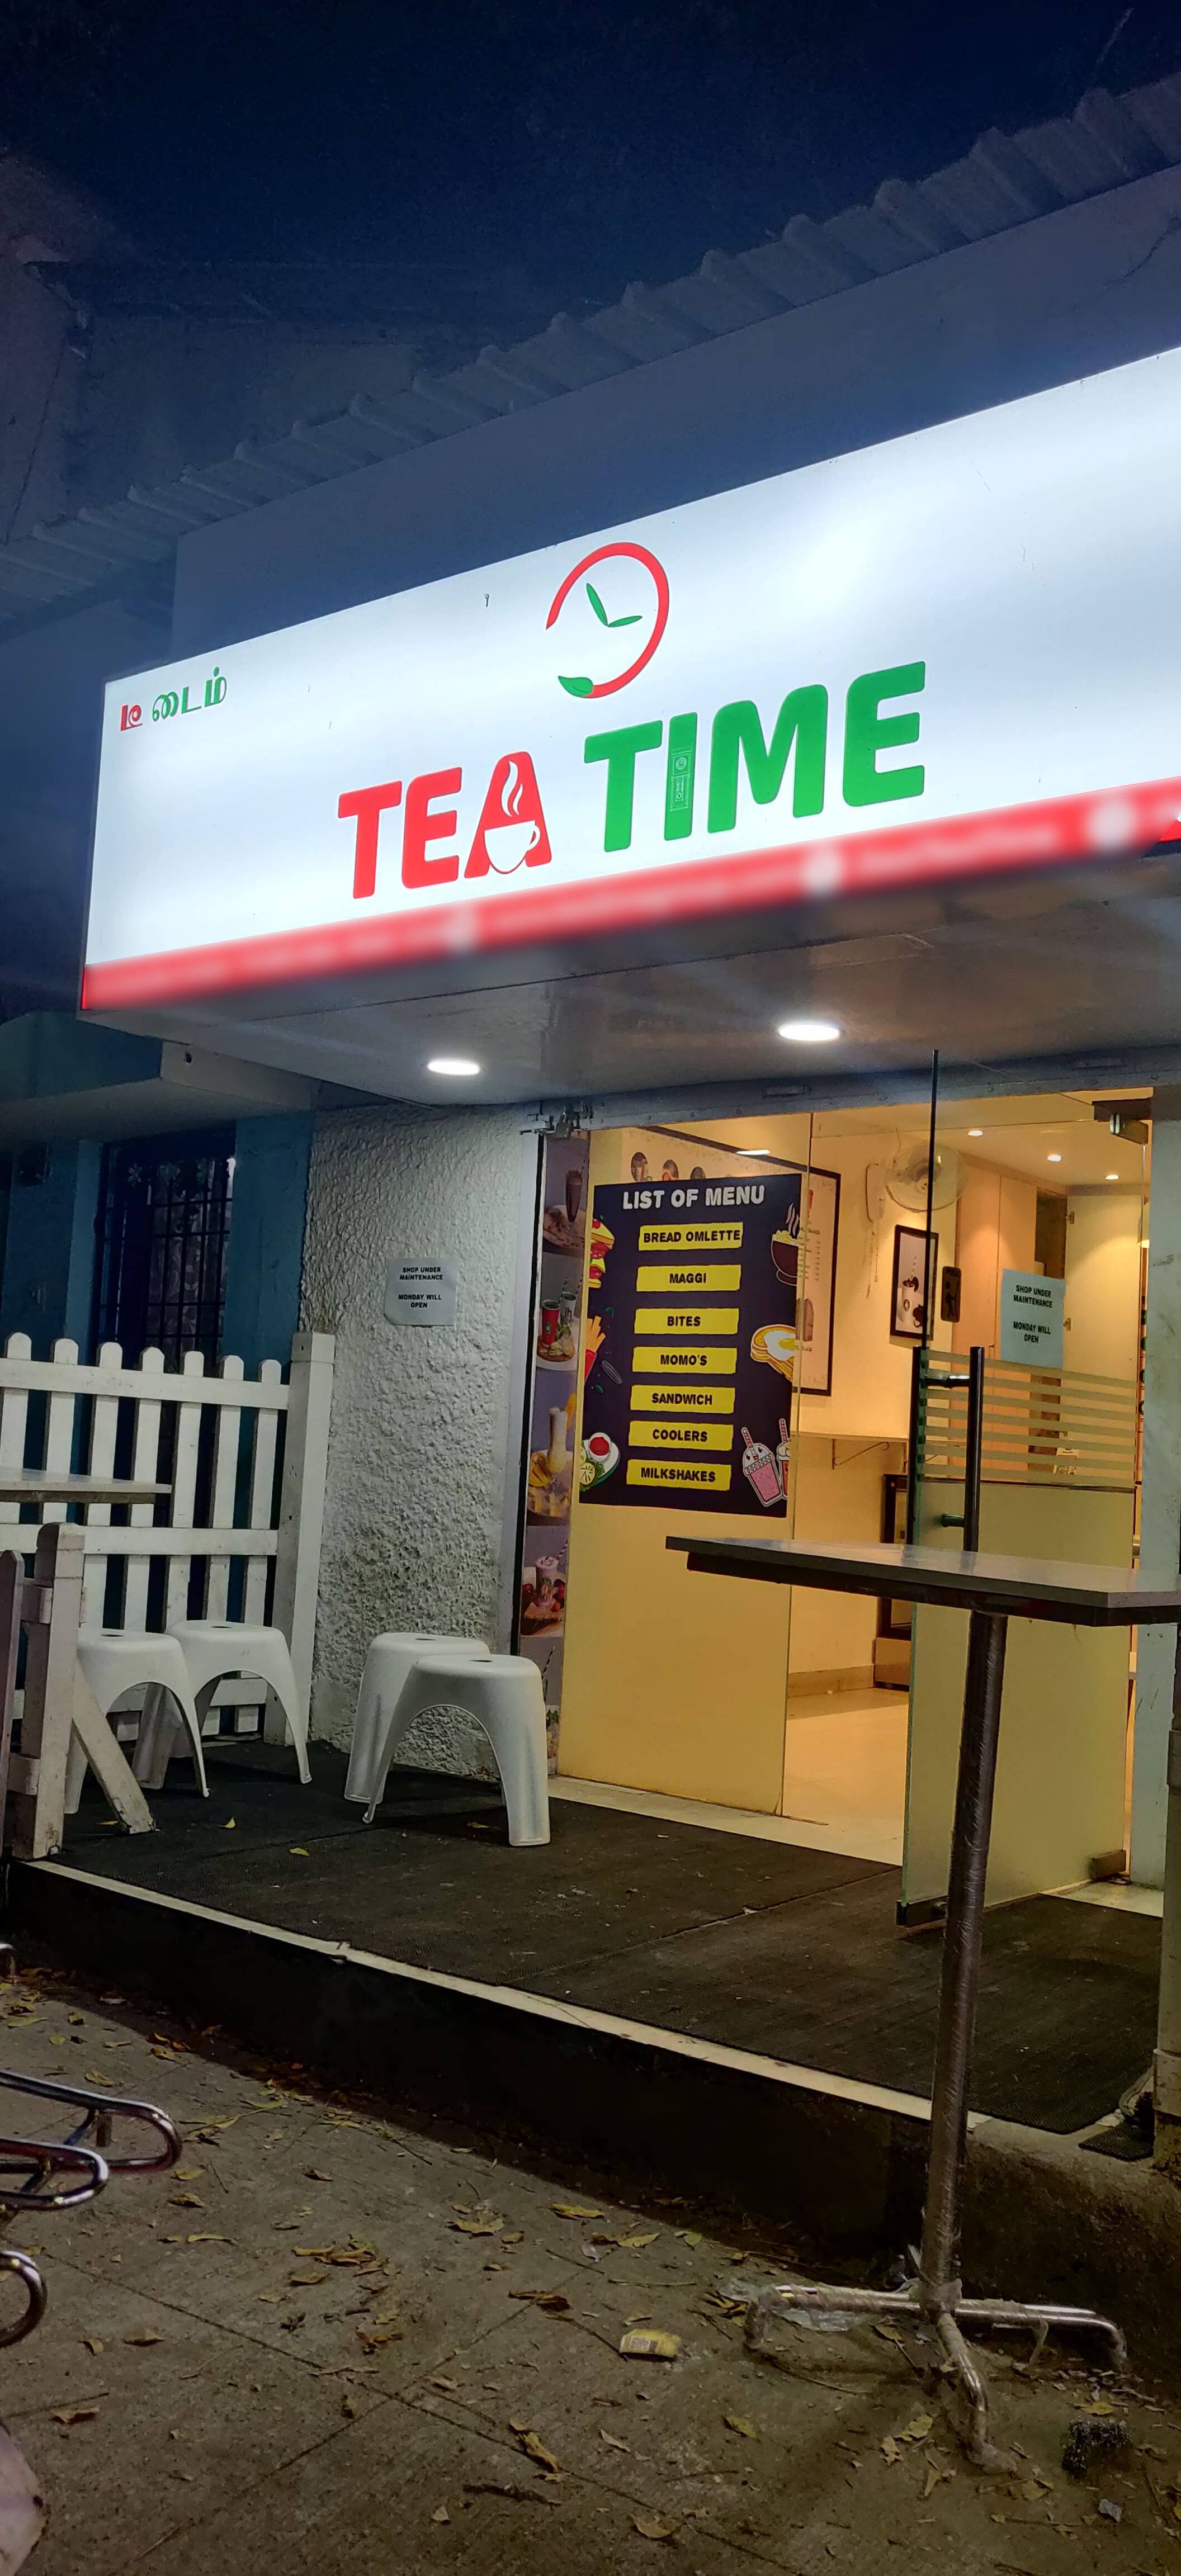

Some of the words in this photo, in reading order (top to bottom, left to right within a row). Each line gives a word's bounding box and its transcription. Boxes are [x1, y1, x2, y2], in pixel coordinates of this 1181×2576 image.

[120, 704, 143, 731] டீ
[152, 666, 228, 722] டைம்
[338, 751, 552, 899] TEA
[584, 661, 926, 853] TIME
[622, 1190, 665, 1210] LIST
[670, 1188, 699, 1208] OF
[705, 1185, 765, 1206] MENU
[643, 1232, 682, 1243] BREAD
[686, 1230, 740, 1242] OMLETTE
[669, 1272, 707, 1284] MAGGI
[1015, 1285, 1032, 1294] SHOP
[1033, 1287, 1051, 1298] UNDER
[1013, 1294, 1052, 1308] MAINTENANCE
[667, 1316, 701, 1327] BITES
[1013, 1321, 1036, 1332] MONDAY
[1037, 1325, 1051, 1334] WILL
[1024, 1333, 1038, 1343] OPEN
[660, 1354, 708, 1367] MOMO'S
[651, 1393, 712, 1406] SANDWICH
[652, 1429, 708, 1442] COOLERS
[640, 1467, 716, 1483] MILKSHAKES
